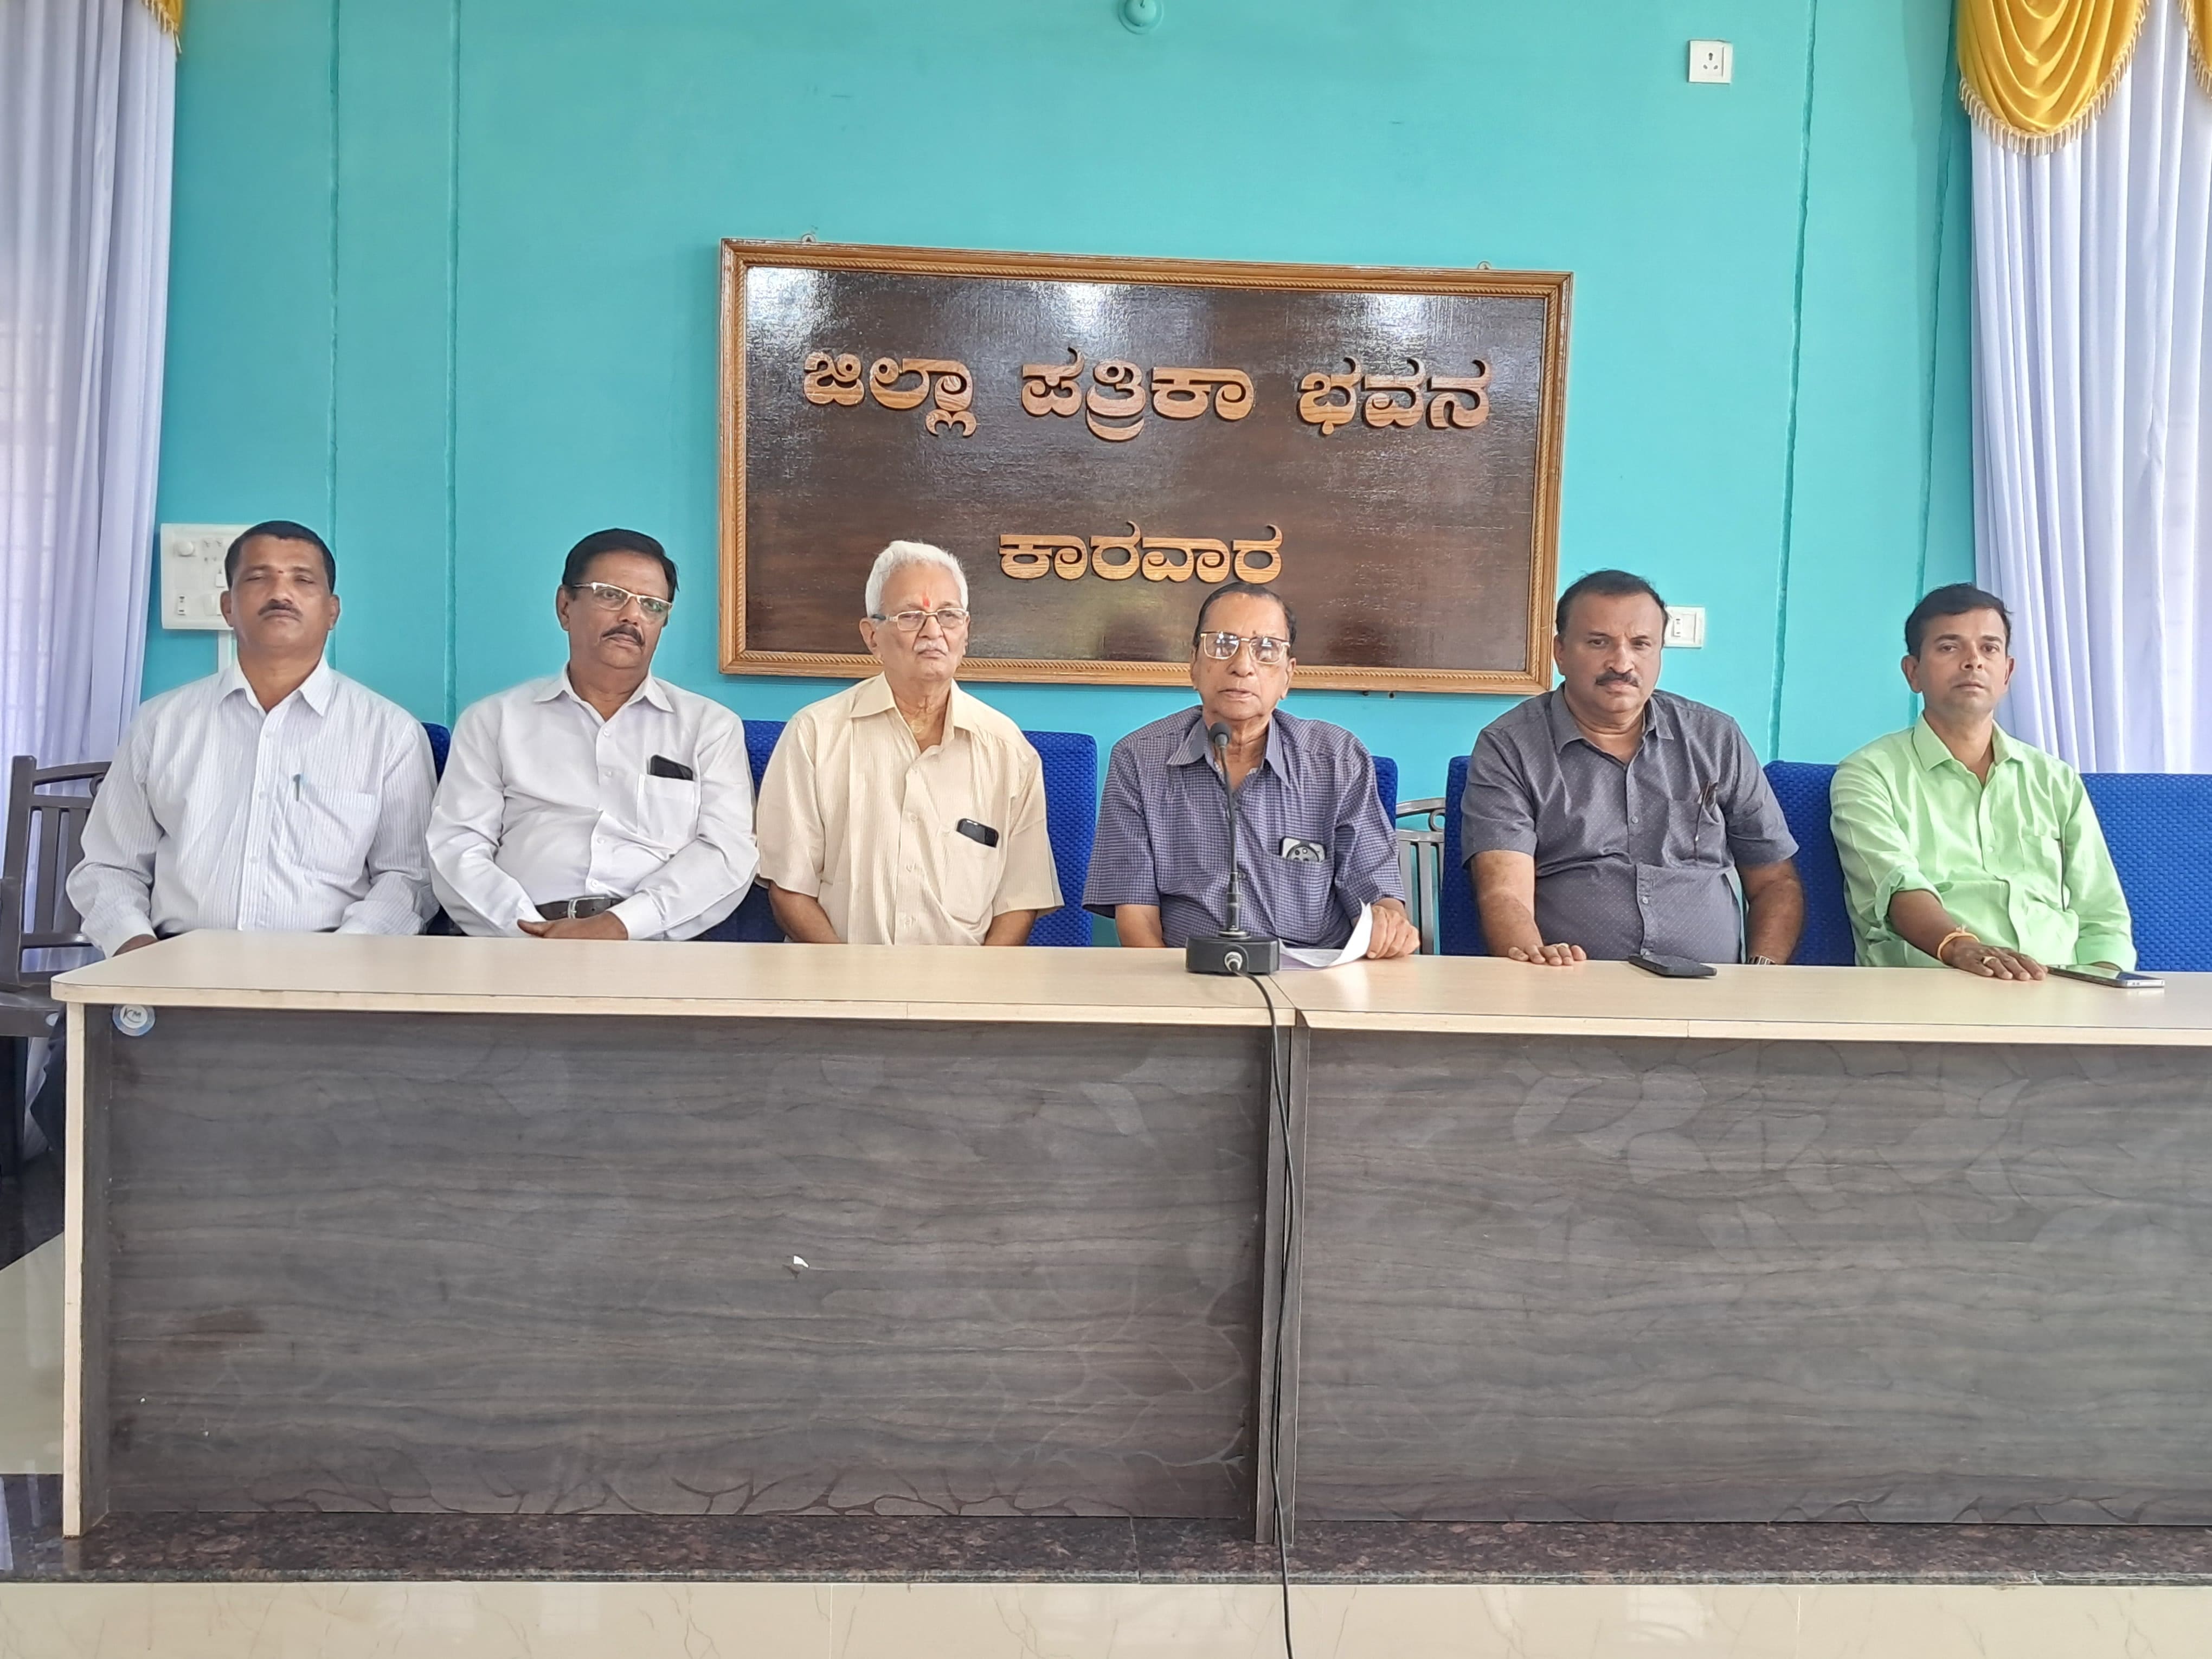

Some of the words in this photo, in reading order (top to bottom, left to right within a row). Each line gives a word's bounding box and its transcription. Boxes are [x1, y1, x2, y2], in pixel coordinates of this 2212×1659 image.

[803, 351, 977, 437] ಜಿಲ್ಲಾ
[1021, 346, 1255, 442] ಪತ್ರಿಕಾ
[1297, 357, 1492, 435] ಭವನ
[998, 520, 1283, 584] ಕಾರವಾರ
